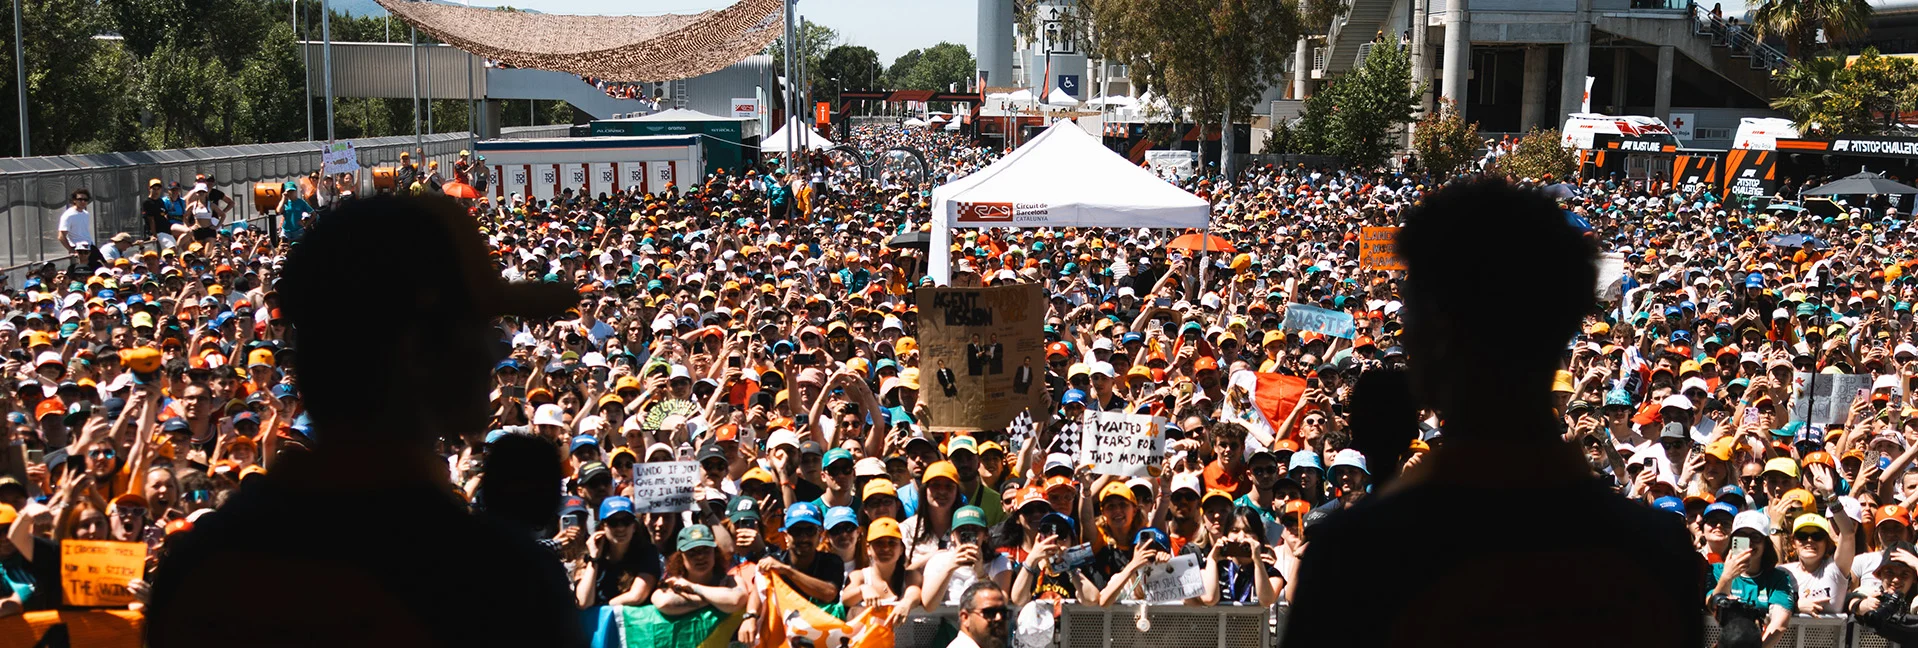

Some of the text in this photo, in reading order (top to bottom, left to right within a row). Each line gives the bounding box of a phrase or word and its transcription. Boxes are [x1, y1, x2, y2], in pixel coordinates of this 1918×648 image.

[1851, 141, 1881, 153] PITSTOP
[1737, 178, 1760, 187] PITSTOP
[1732, 186, 1764, 196] CHALLENGE
[1364, 231, 1394, 240] LAND
[933, 291, 980, 308] AGENT
[946, 307, 993, 326] MISSION
[1095, 420, 1141, 435] WAITED
[1145, 421, 1159, 438] 24
[1095, 434, 1156, 450] YEARS FOR
[1090, 450, 1164, 465] THIS MOMENT
[637, 466, 662, 476] LANDO
[668, 465, 677, 474] IF
[635, 476, 693, 486] GIVE ME YOUR
[638, 489, 654, 497] CAP
[648, 501, 661, 510] YOU
[69, 579, 92, 596] THE
